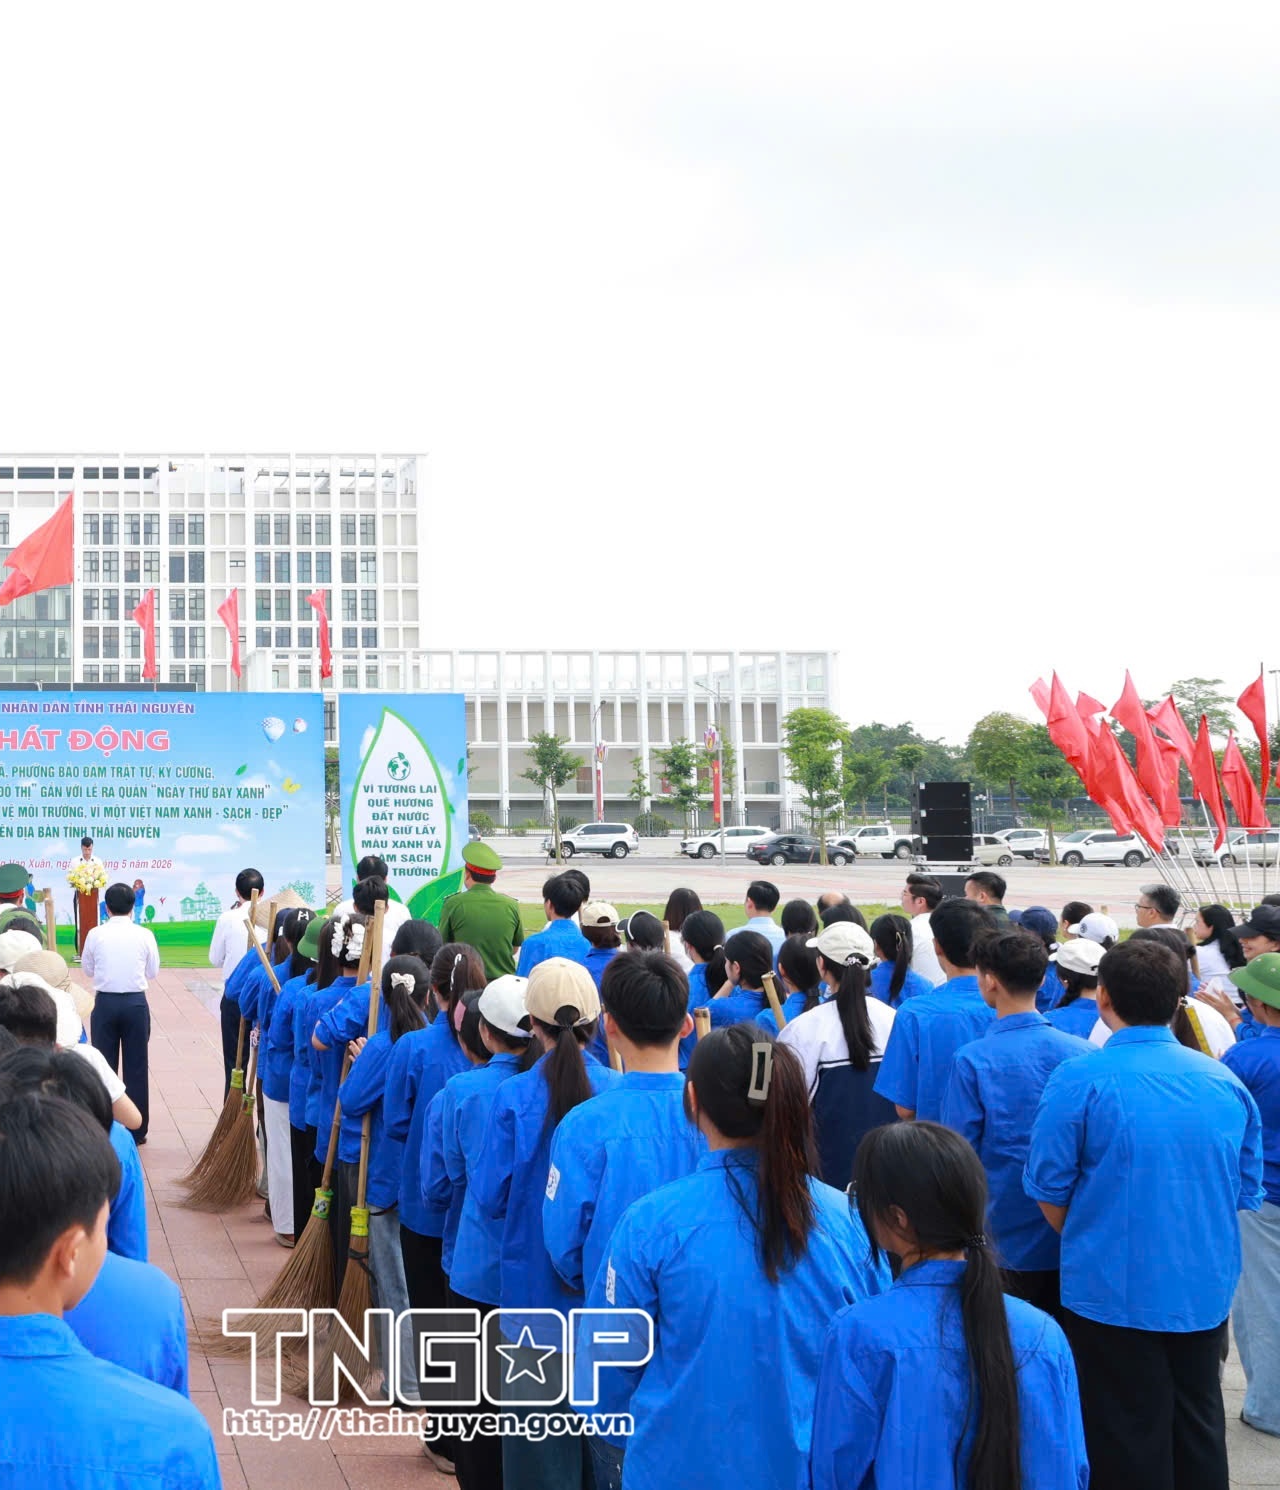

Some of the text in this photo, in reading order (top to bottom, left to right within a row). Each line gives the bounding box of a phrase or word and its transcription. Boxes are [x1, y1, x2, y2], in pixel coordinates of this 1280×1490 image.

[1, 701, 38, 713] NHÂN
[42, 701, 70, 713] DÂN
[74, 700, 104, 713] TỈNH
[108, 701, 137, 713] THÁI
[141, 701, 195, 714] NGUYÊN
[68, 726, 169, 757] ĐỘNG
[12, 763, 55, 777] PHƯỜNG
[58, 762, 80, 777] BẢO
[83, 763, 107, 778] ĐẢM
[110, 763, 136, 780] TRẬT
[40, 782, 62, 798] GẮN
[66, 783, 83, 798] VỚI
[101, 786, 115, 798] RA
[118, 784, 148, 799] QUÂN
[189, 785, 210, 799] THỨ
[212, 784, 232, 799] BẢY
[363, 784, 437, 794] VÌ TƯƠNG LAI
[367, 797, 434, 808] QUÊ HƯƠNG
[1, 804, 14, 820] VỆ
[18, 804, 38, 818] MÔI
[90, 804, 100, 818] VÌ
[104, 804, 126, 820] MỘT
[129, 804, 152, 820] VIỆT
[155, 807, 180, 818] NAM
[183, 807, 212, 818] XANH
[223, 807, 251, 821] SẠCH
[371, 809, 430, 821] ĐẤT NƯỚC
[17, 826, 34, 840] ĐỊA
[38, 823, 60, 838] BÀN
[63, 823, 87, 838] TỈNH
[90, 824, 114, 838] THÁI
[117, 824, 160, 838] NGUYÊN
[366, 823, 436, 835] HÃY GIỮ LẤY
[361, 838, 442, 849] MÀU XANH VÀ
[121, 860, 127, 869] 5
[129, 858, 149, 869] năm
[151, 860, 172, 869] 2026
[372, 852, 432, 864] ÀM SẠCH
[392, 866, 438, 877] TRƯỜNG
